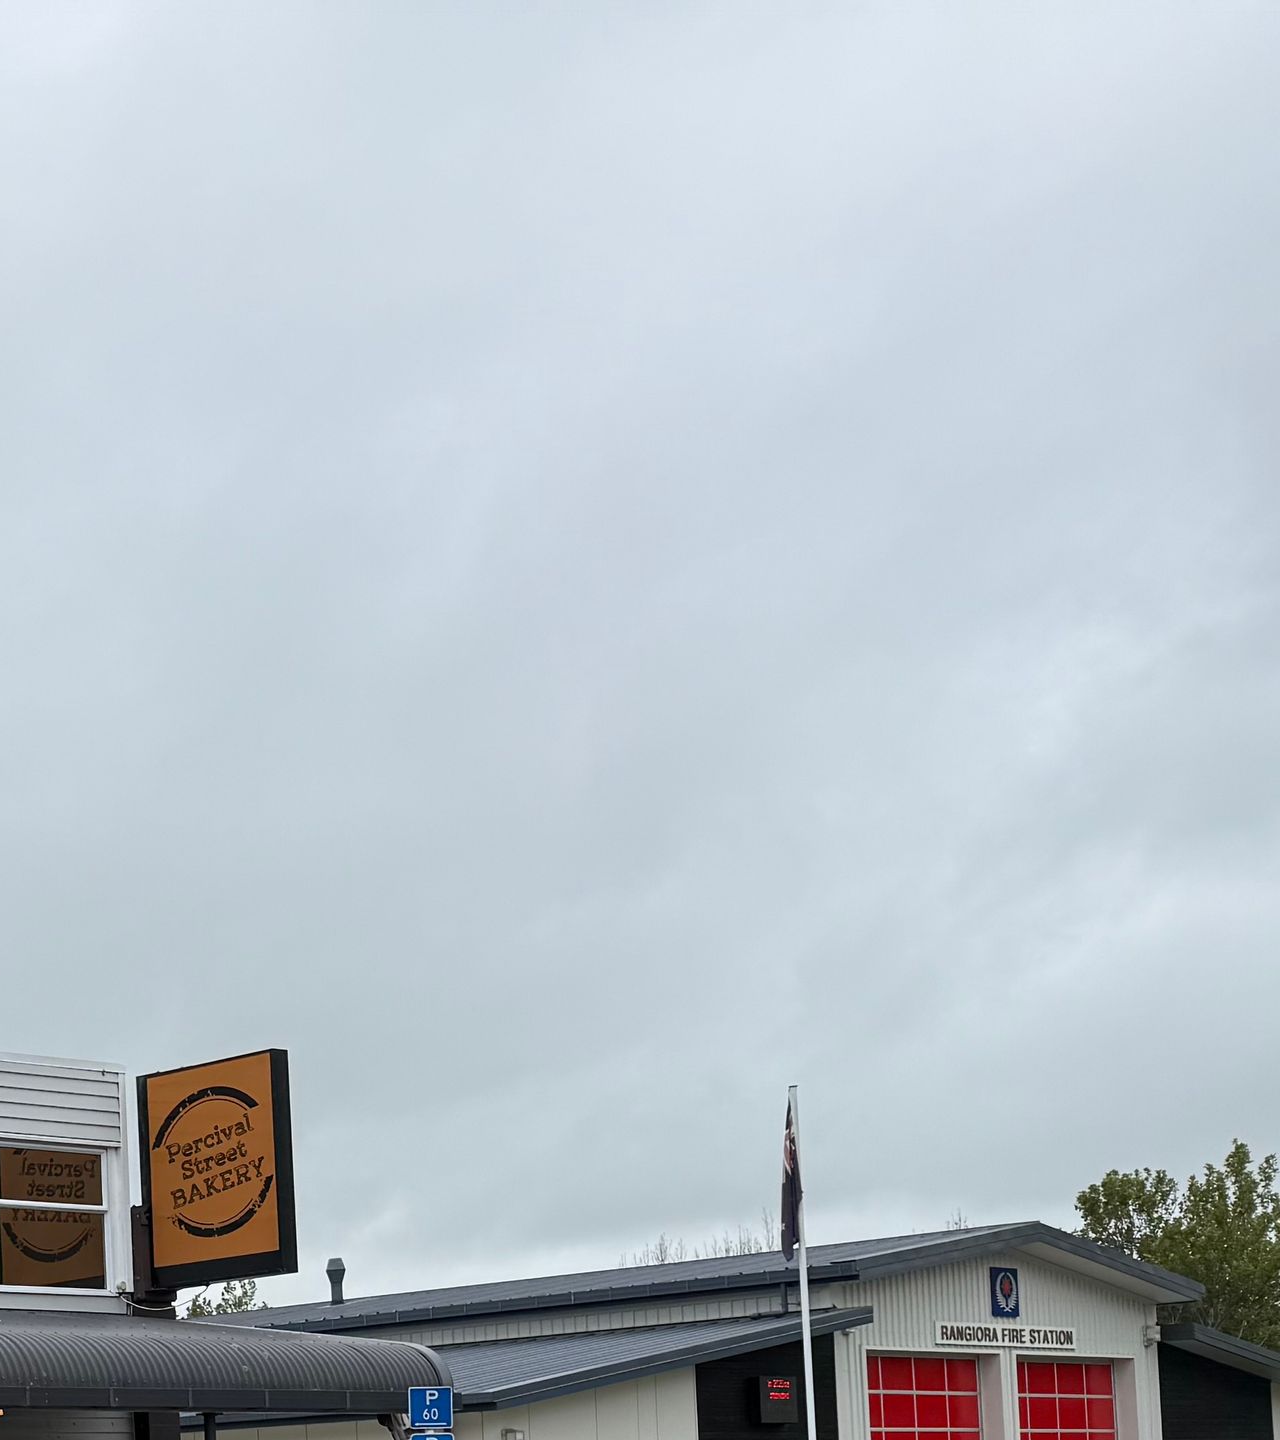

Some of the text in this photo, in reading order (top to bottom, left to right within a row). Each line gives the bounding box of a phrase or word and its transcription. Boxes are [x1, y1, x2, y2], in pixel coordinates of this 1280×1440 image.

[166, 1112, 254, 1164] Percival
[181, 1140, 248, 1180] Street
[170, 1156, 265, 1210] BAKERY
[941, 1325, 1074, 1345] RANGIORA FIRE STATION
[425, 1390, 439, 1405] P
[423, 1408, 438, 1420] 60
